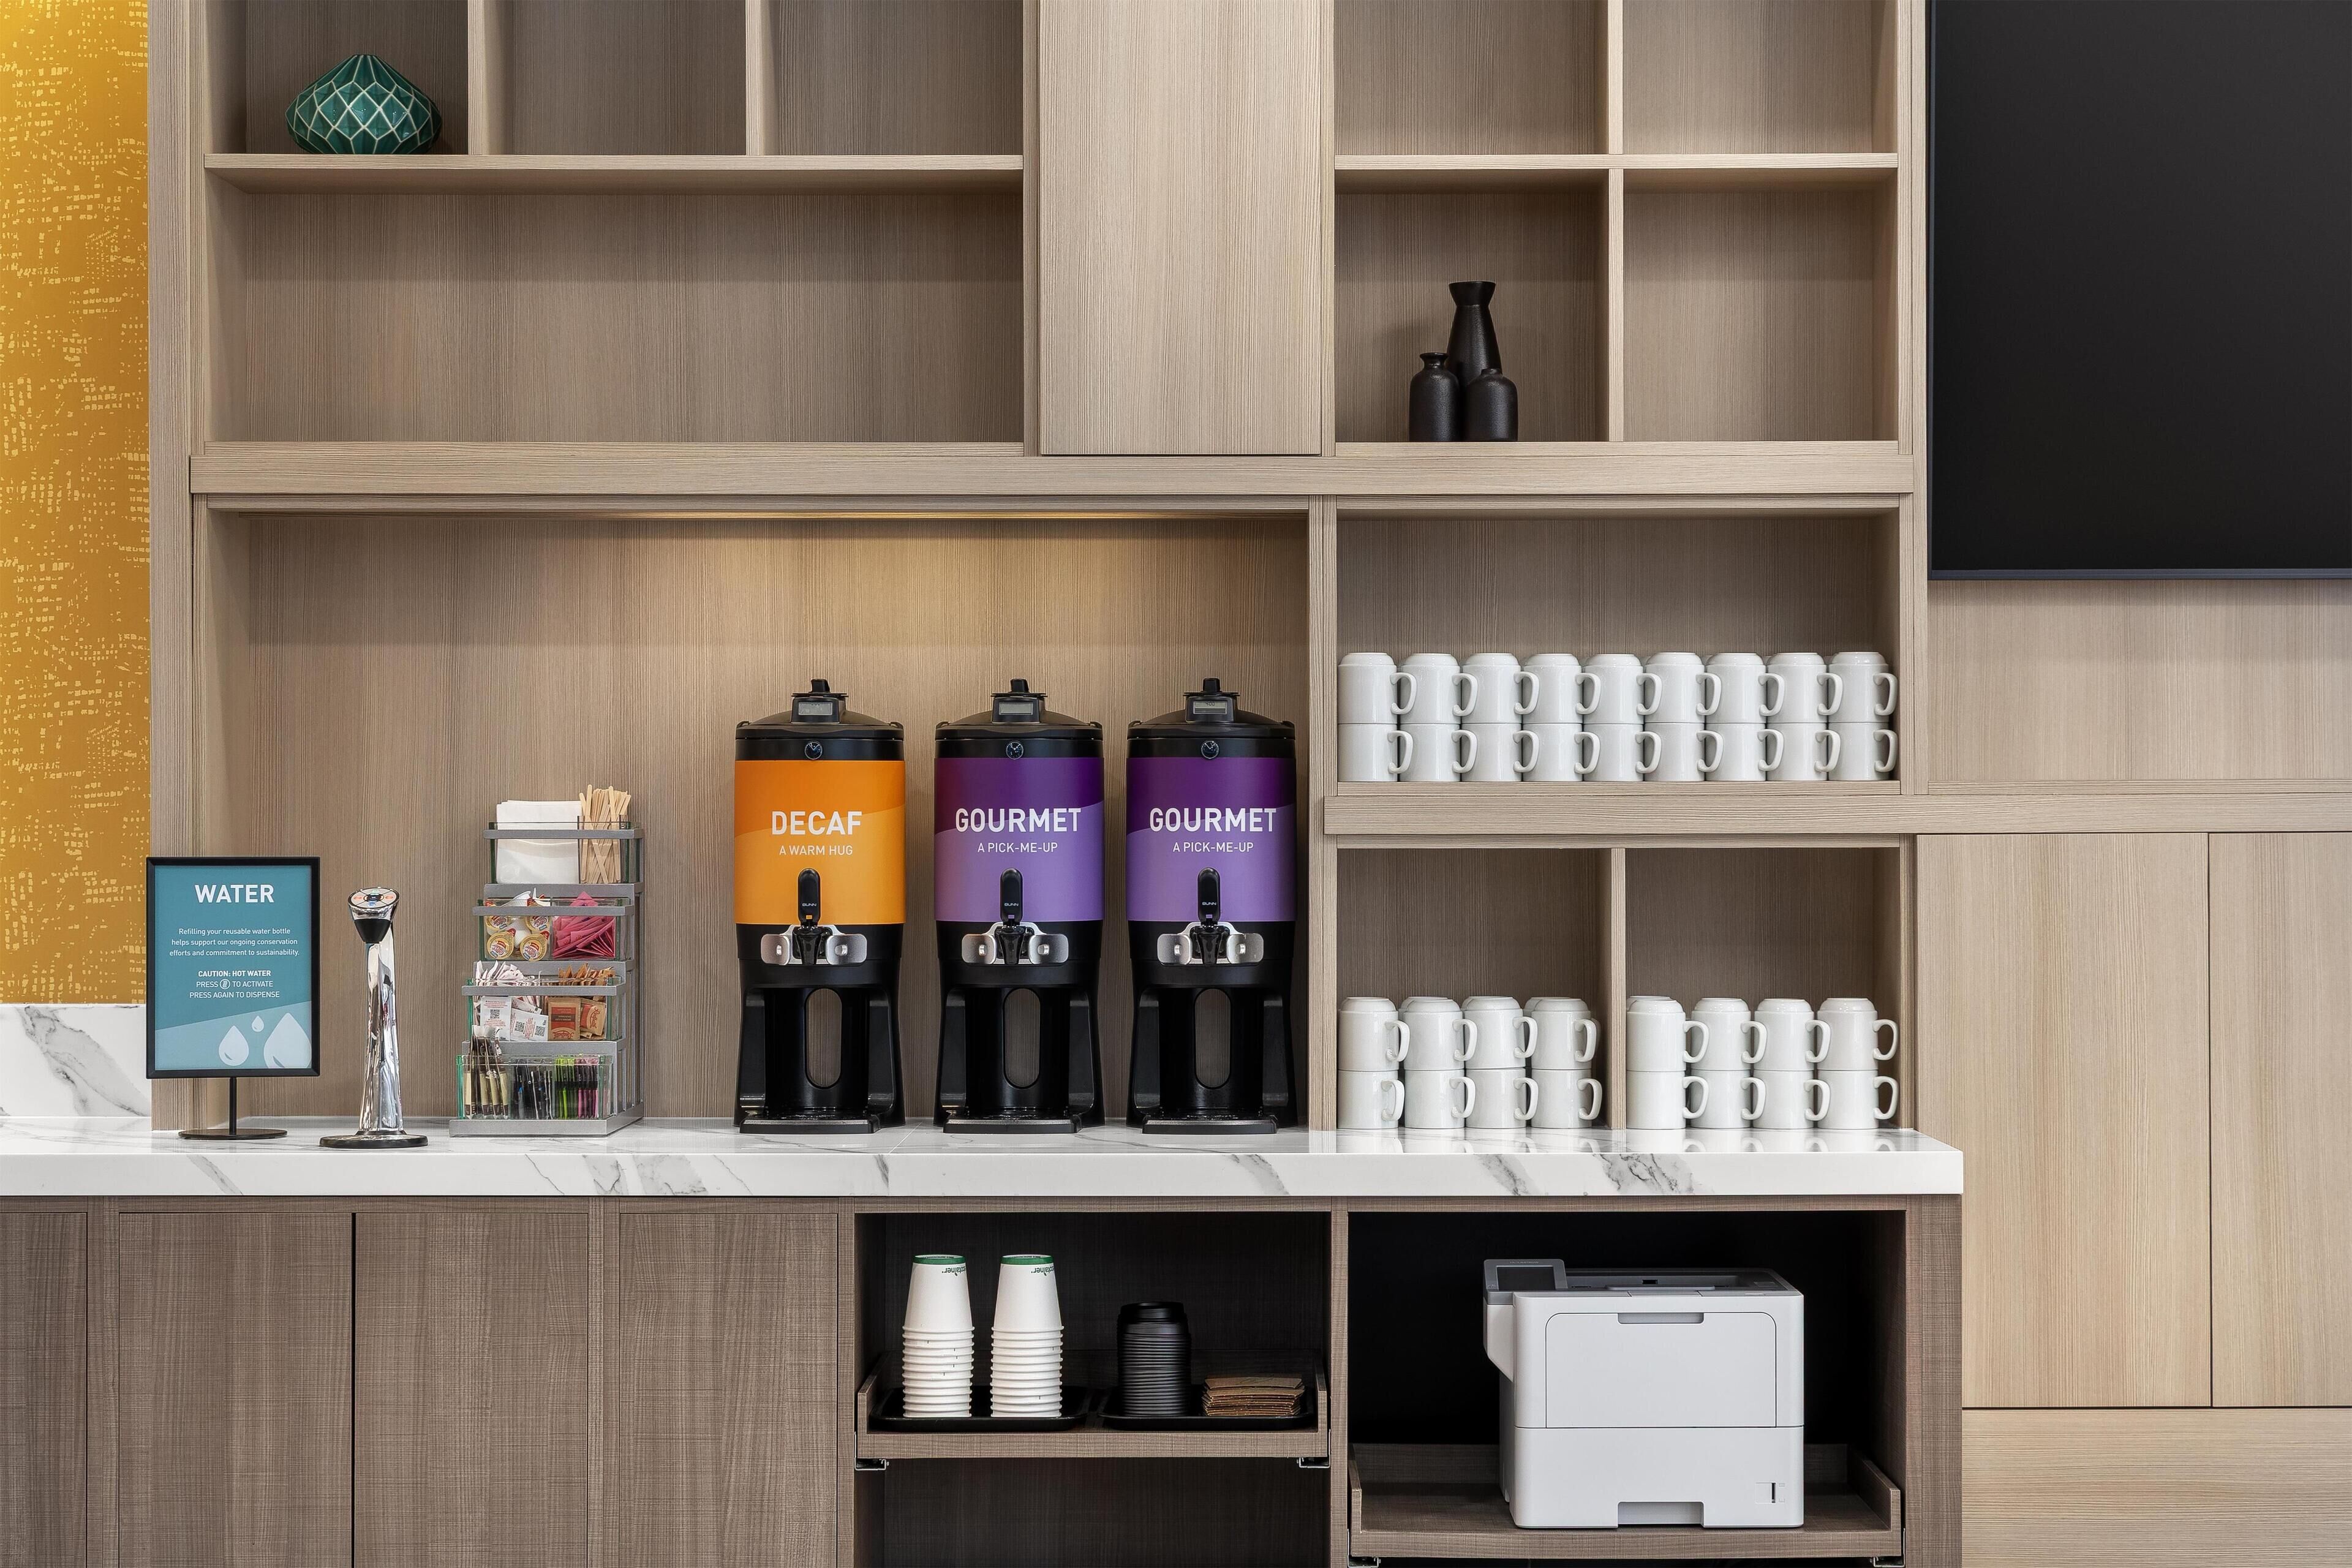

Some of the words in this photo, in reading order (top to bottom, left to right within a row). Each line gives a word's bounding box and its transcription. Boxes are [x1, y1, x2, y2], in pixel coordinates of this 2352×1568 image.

[772, 811, 862, 835] DECAF
[956, 808, 1081, 832] GOURMET
[1150, 808, 1276, 832] GOURMET
[779, 845, 786, 855] A
[789, 845, 825, 856] WARM
[829, 845, 853, 856] HUG
[978, 842, 985, 853] A
[988, 842, 1058, 853] PICK-ME-UP
[1173, 842, 1180, 852] A
[1183, 842, 1254, 853] PICK-ME-UP
[194, 884, 275, 903] WATER
[179, 928, 206, 937] Refilling
